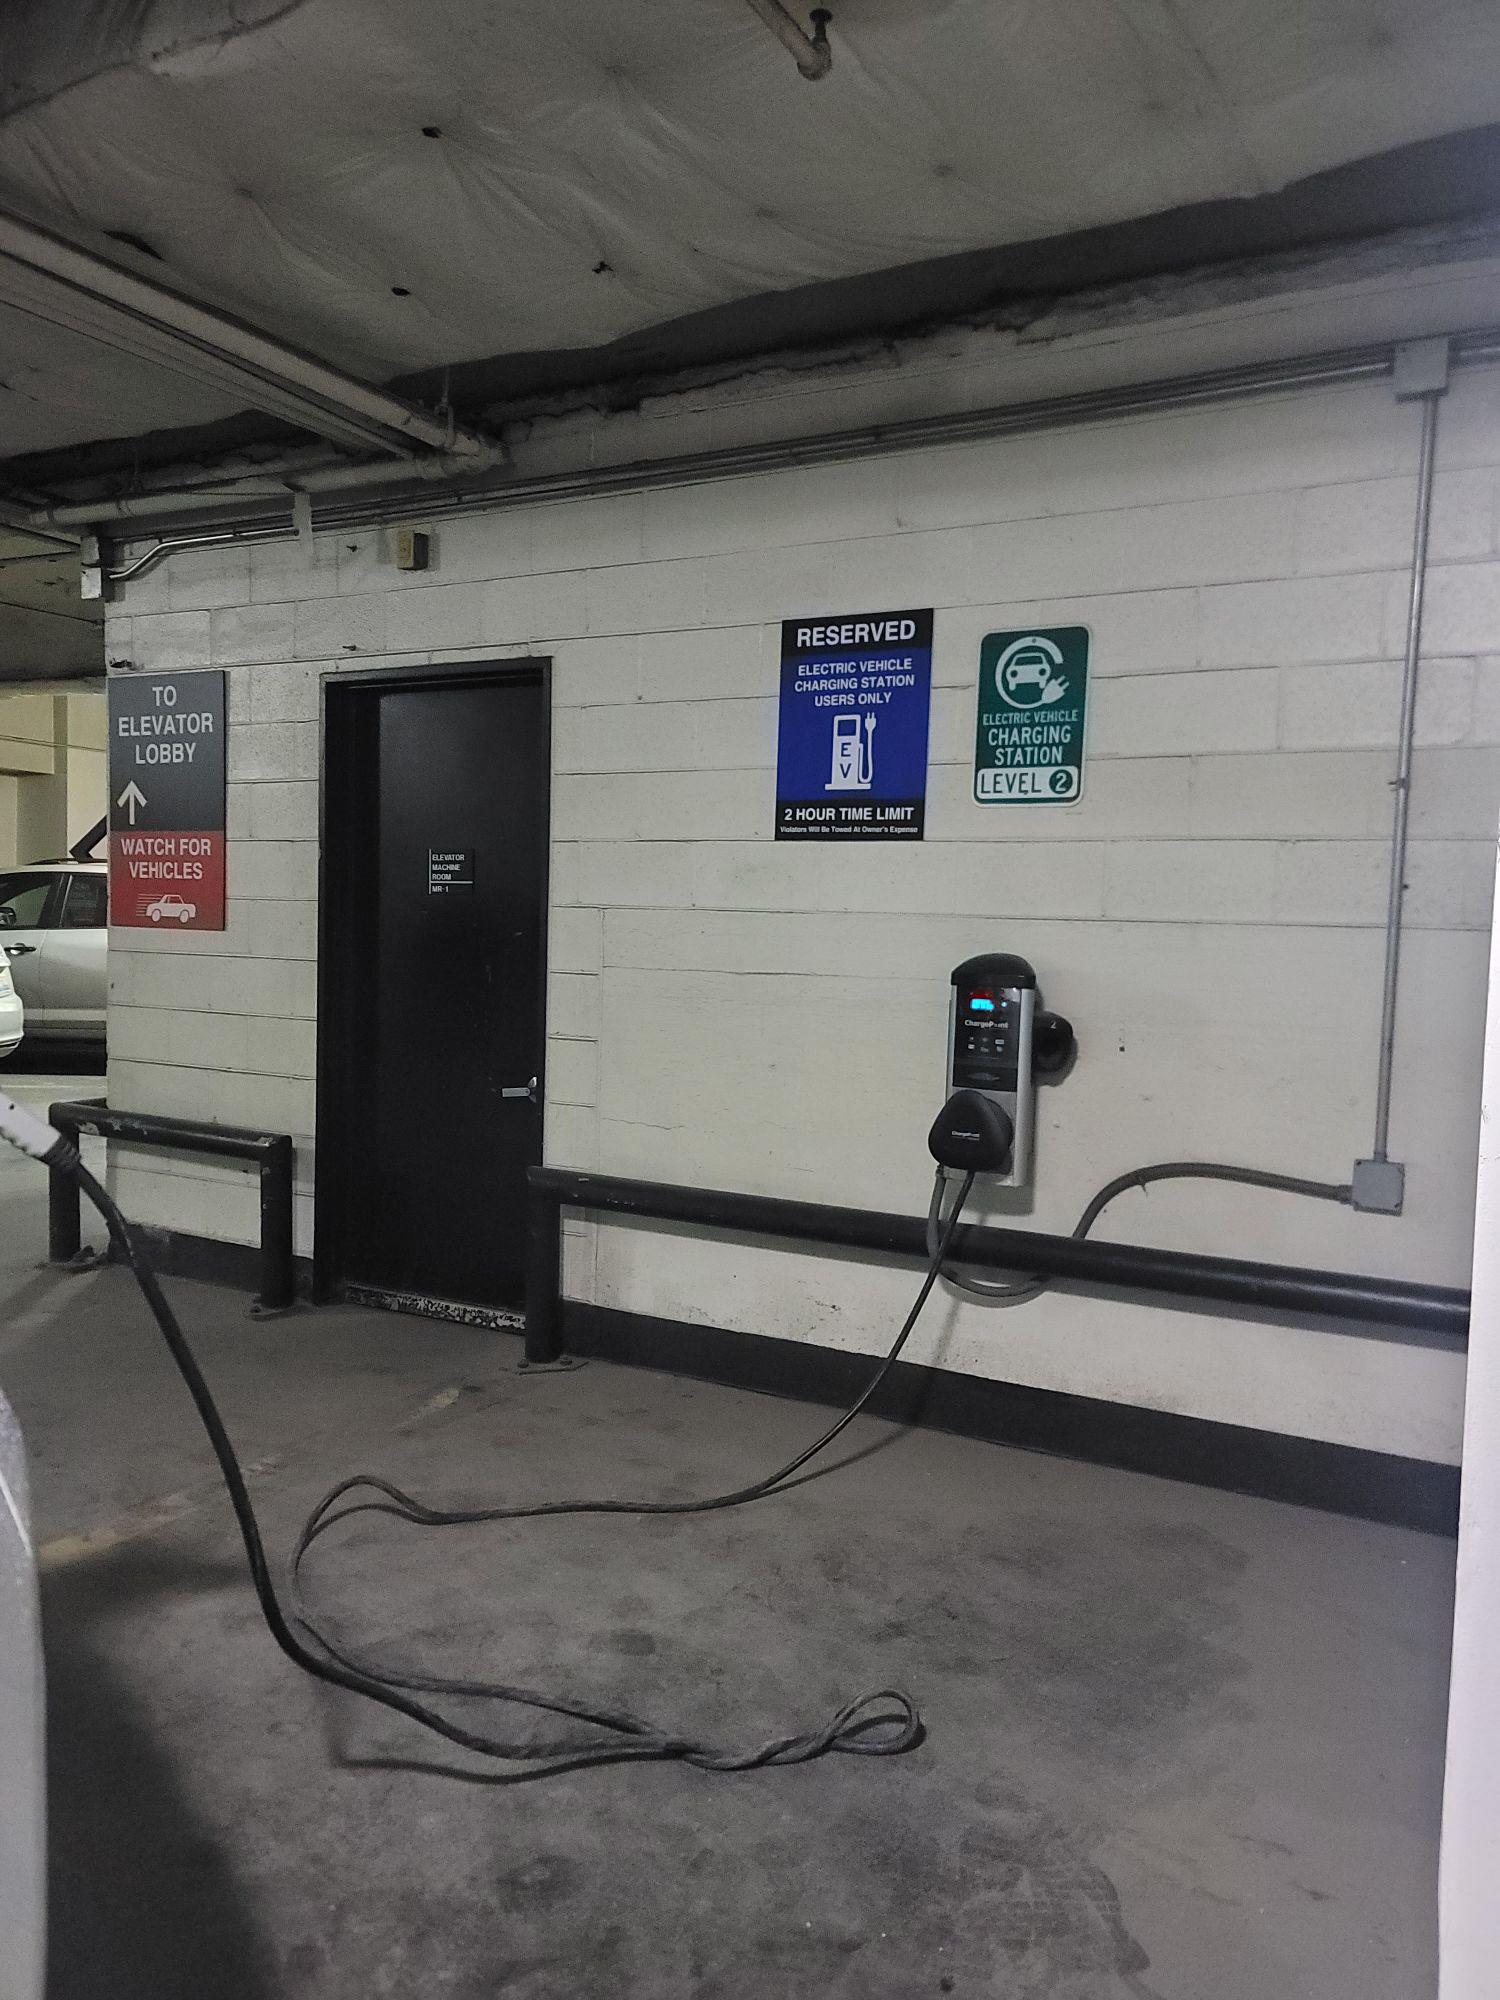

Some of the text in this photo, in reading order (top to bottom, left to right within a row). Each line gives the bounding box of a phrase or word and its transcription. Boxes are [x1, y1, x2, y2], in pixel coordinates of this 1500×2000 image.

[797, 620, 916, 648] RESERVED
[798, 658, 912, 676] ELECTRIC VEHICLE
[794, 674, 915, 693] CHARGING STATION
[152, 685, 177, 707] TO
[814, 692, 892, 707] USERS ONLY
[118, 712, 213, 737] ELEVATOR
[982, 709, 1079, 726] ELECTRIC VEHICLE
[988, 725, 1072, 746] CHARGING
[135, 742, 197, 765] LOBBY
[994, 745, 1064, 766] STATION
[980, 772, 1067, 795] LEVEL 2
[784, 807, 915, 821] 2 HOUR TIME LIMIT
[890, 826, 918, 834] Expense
[121, 838, 212, 856] WATCH FOR
[128, 861, 204, 880] VEHICLES
